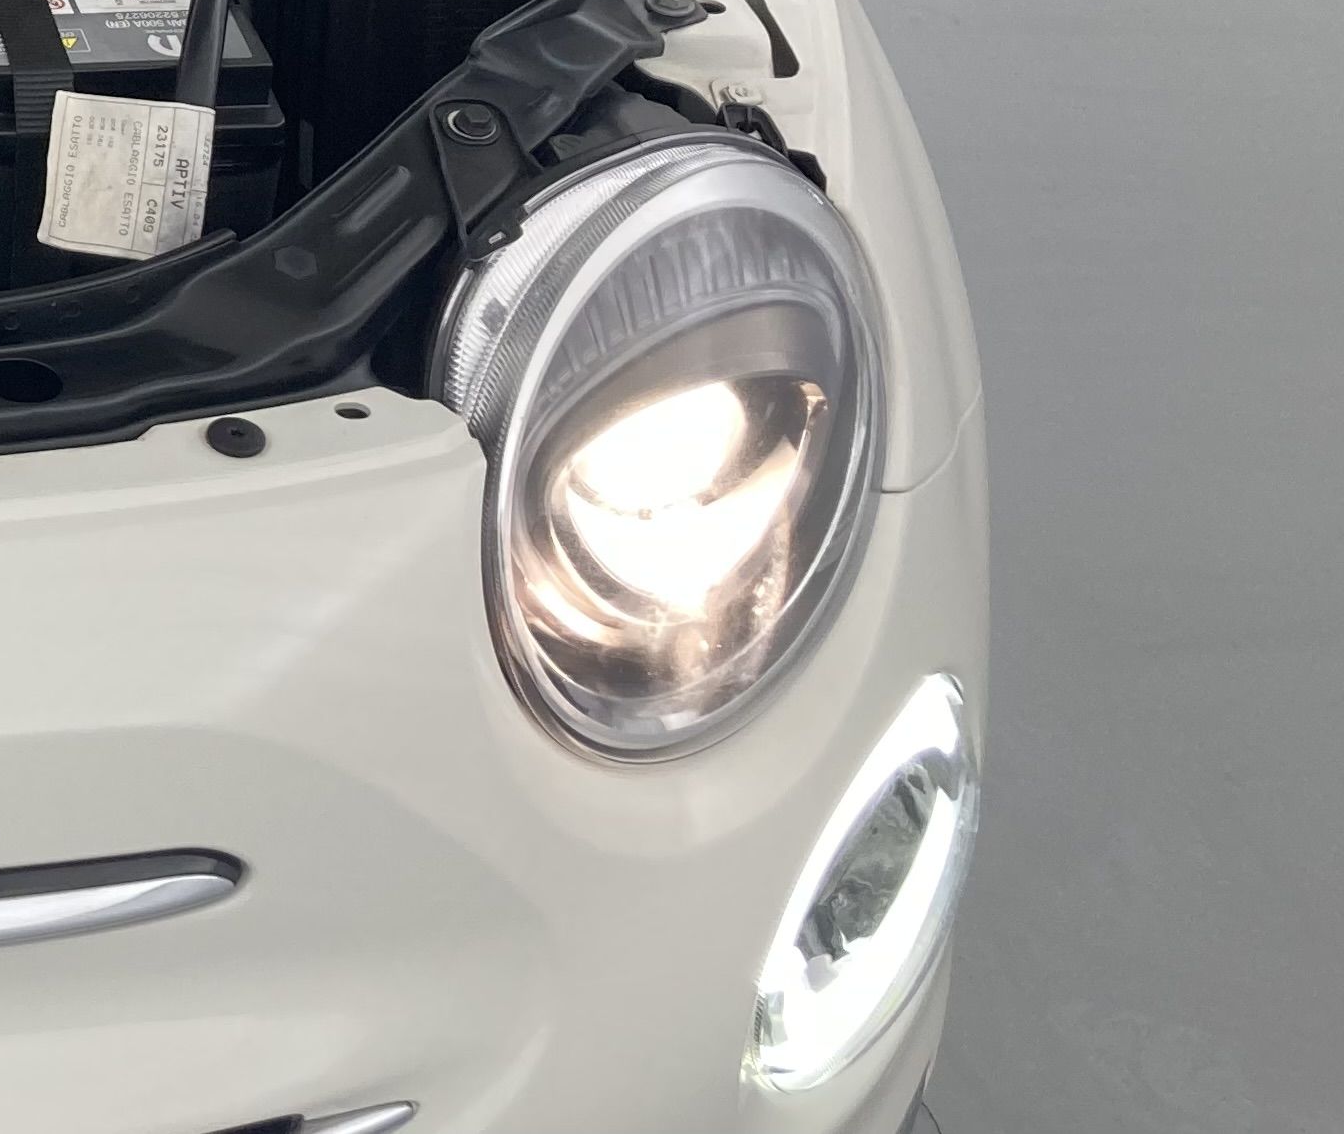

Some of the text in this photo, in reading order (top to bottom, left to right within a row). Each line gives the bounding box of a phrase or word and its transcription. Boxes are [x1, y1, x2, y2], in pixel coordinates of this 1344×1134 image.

[58, 115, 83, 228] CABLAGGIO ESATTO
[153, 125, 169, 168] 23175
[118, 120, 143, 236] CABLAGGIO ESATTO
[170, 158, 190, 210] APTIV
[142, 198, 158, 233] C409
